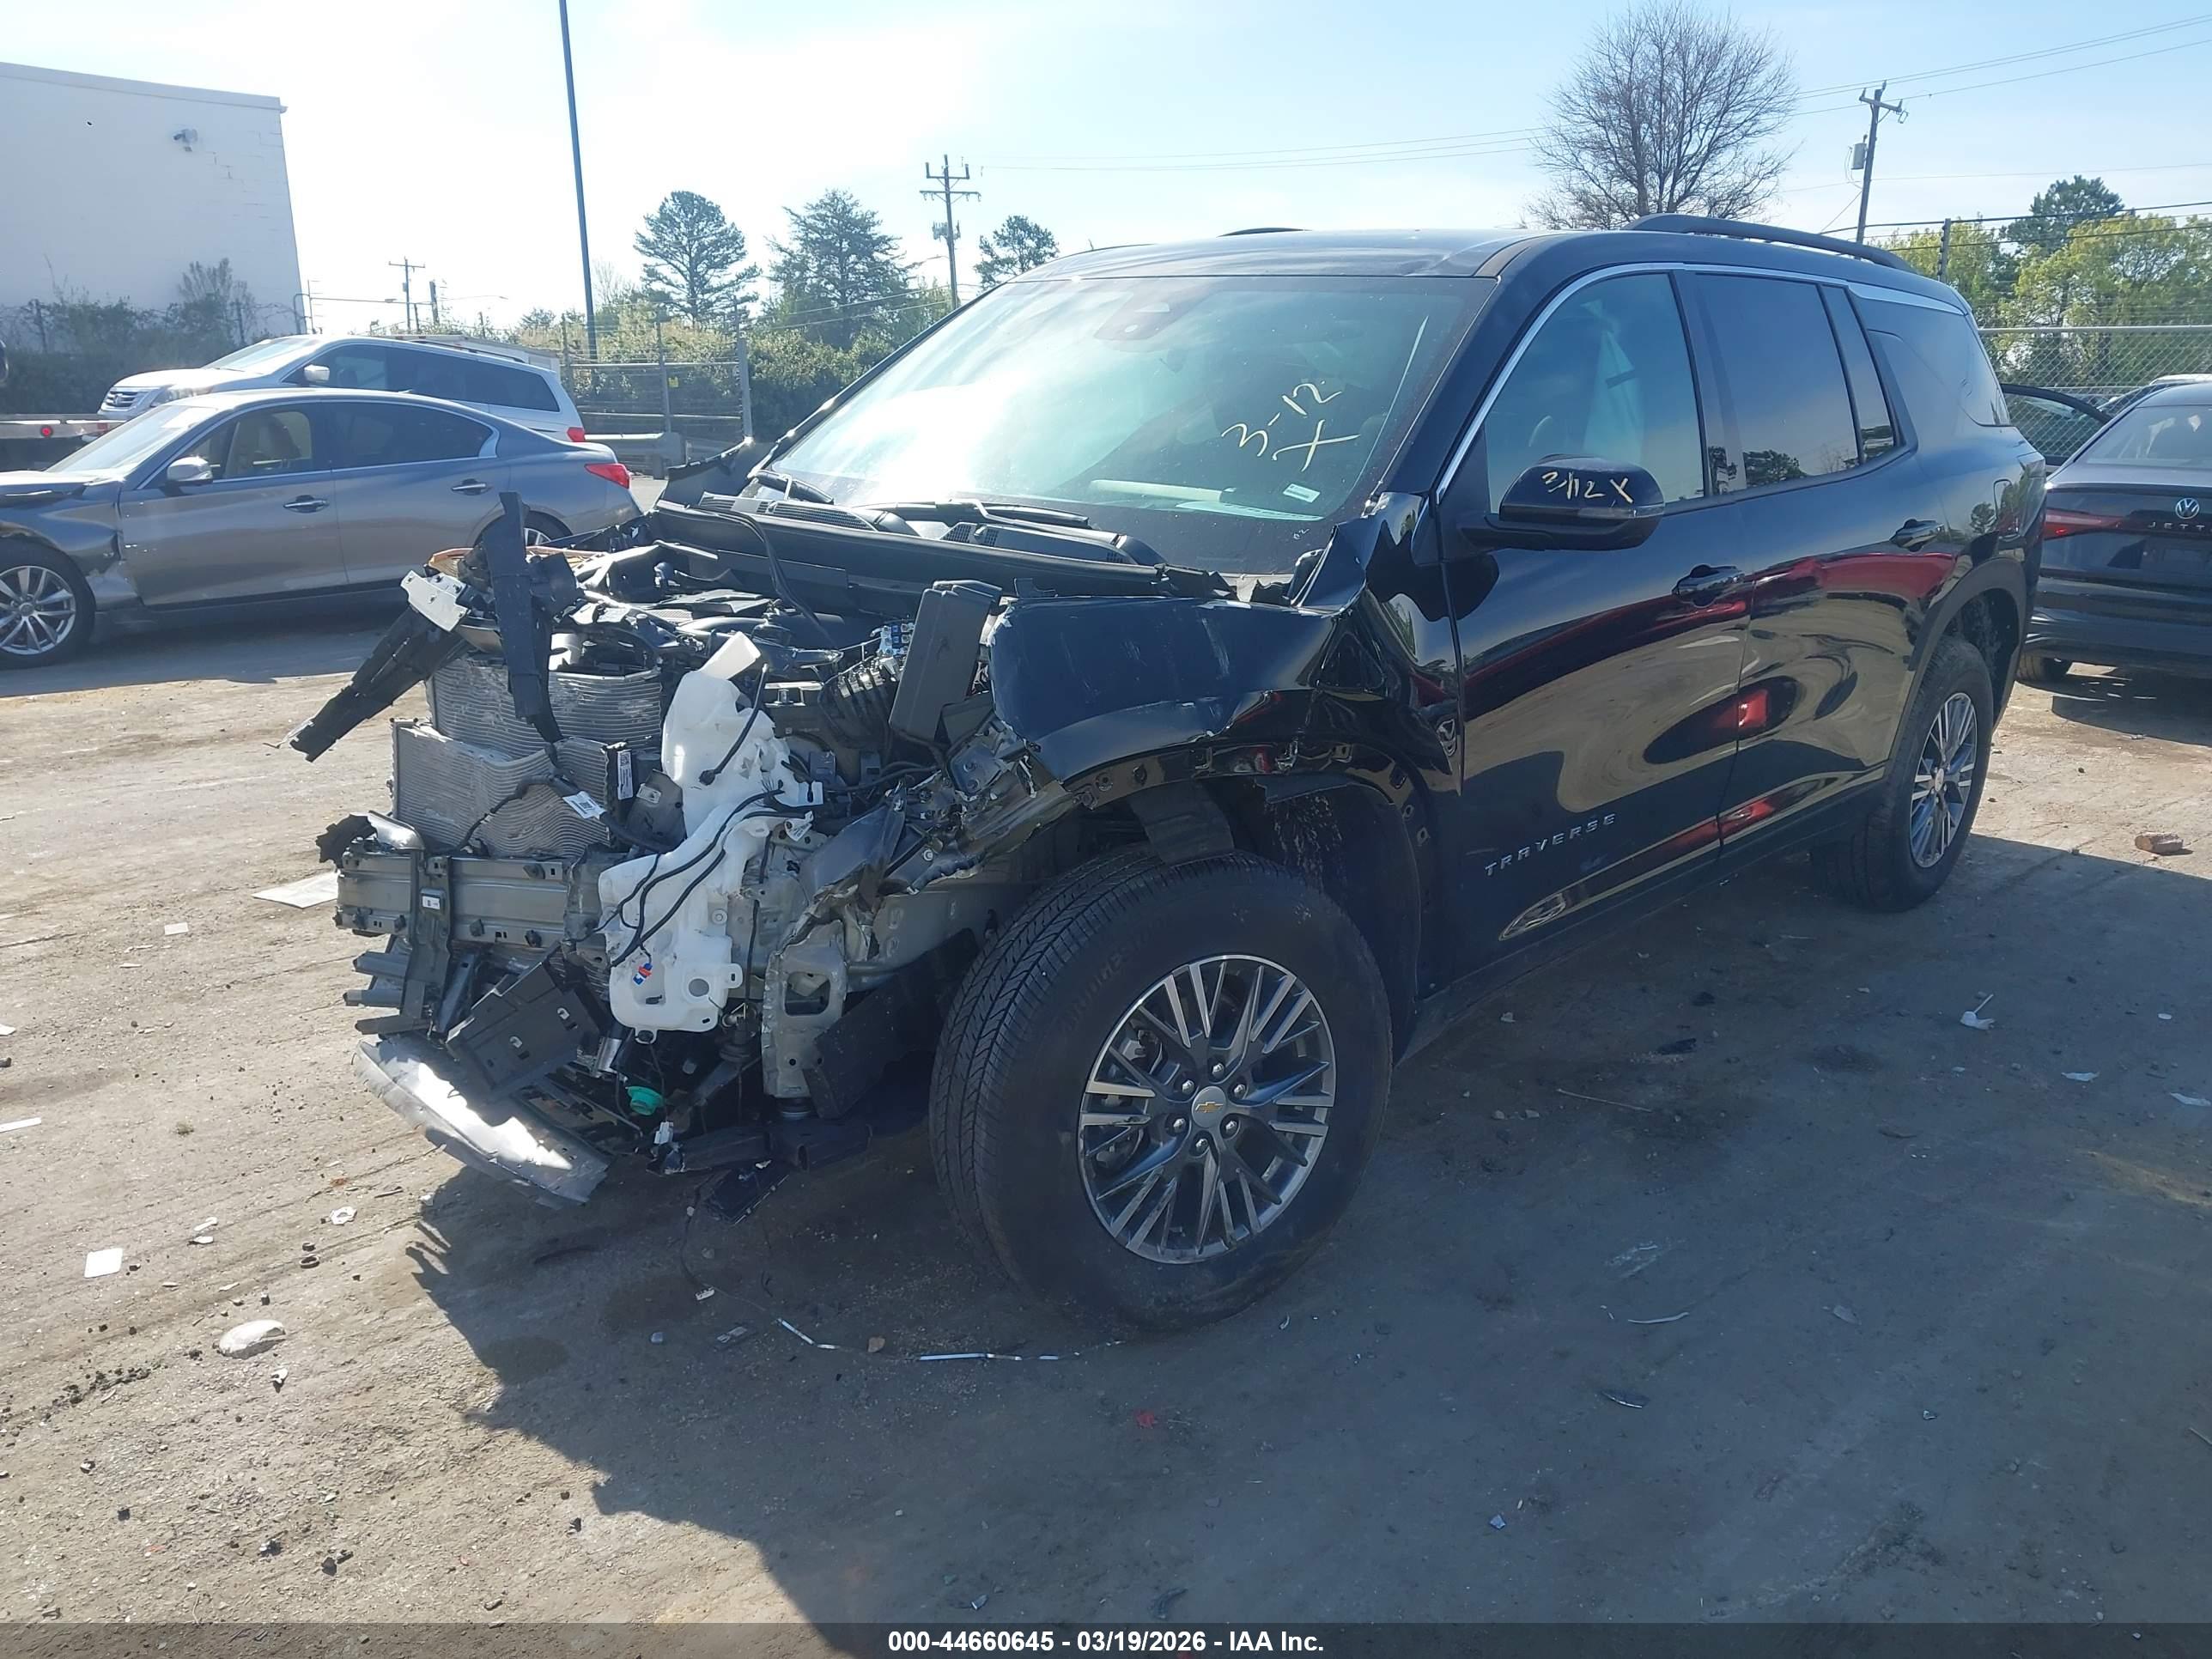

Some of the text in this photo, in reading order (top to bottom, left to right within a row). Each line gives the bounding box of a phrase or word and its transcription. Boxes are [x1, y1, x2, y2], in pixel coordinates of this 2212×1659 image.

[1221, 381, 1342, 458] 3-12
[1272, 419, 1361, 472] X
[2148, 521, 2212, 532] JETT
[1485, 813, 1617, 877] TRAVERSE
